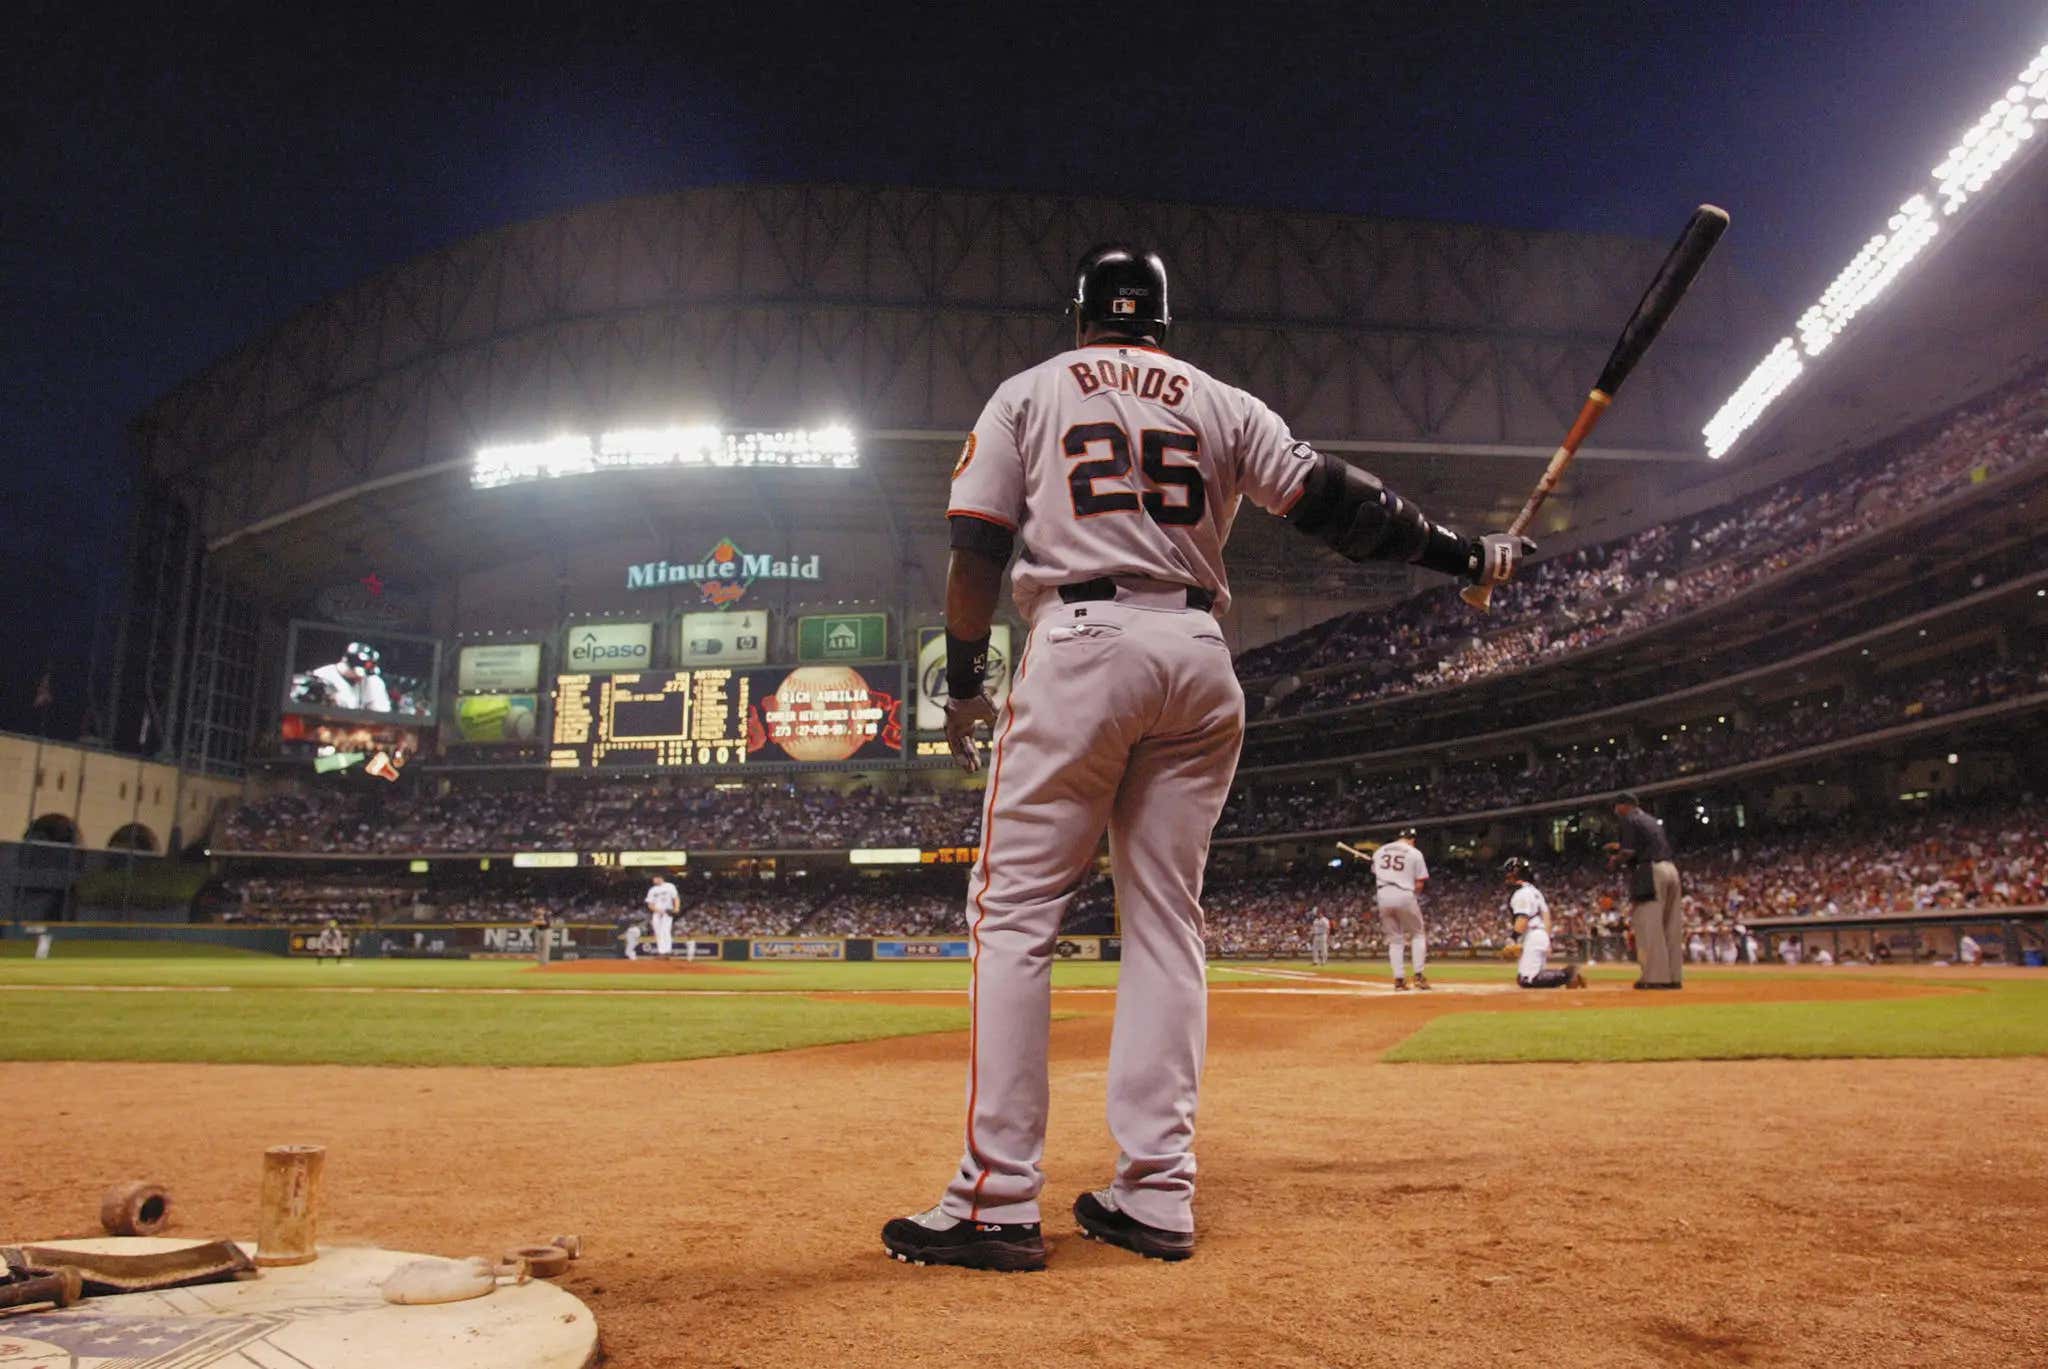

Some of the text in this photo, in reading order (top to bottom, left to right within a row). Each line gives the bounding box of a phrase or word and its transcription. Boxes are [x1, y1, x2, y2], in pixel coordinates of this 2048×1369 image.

[1119, 287, 1148, 296] BONDS
[1068, 359, 1189, 406] BONDS
[1061, 422, 1206, 527] 25
[627, 554, 820, 589] Minute Maid
[698, 747, 710, 764] 0
[716, 747, 729, 764] 0
[736, 747, 745, 764] 1
[1380, 854, 1405, 871] 35
[484, 926, 576, 949] NEXEL
